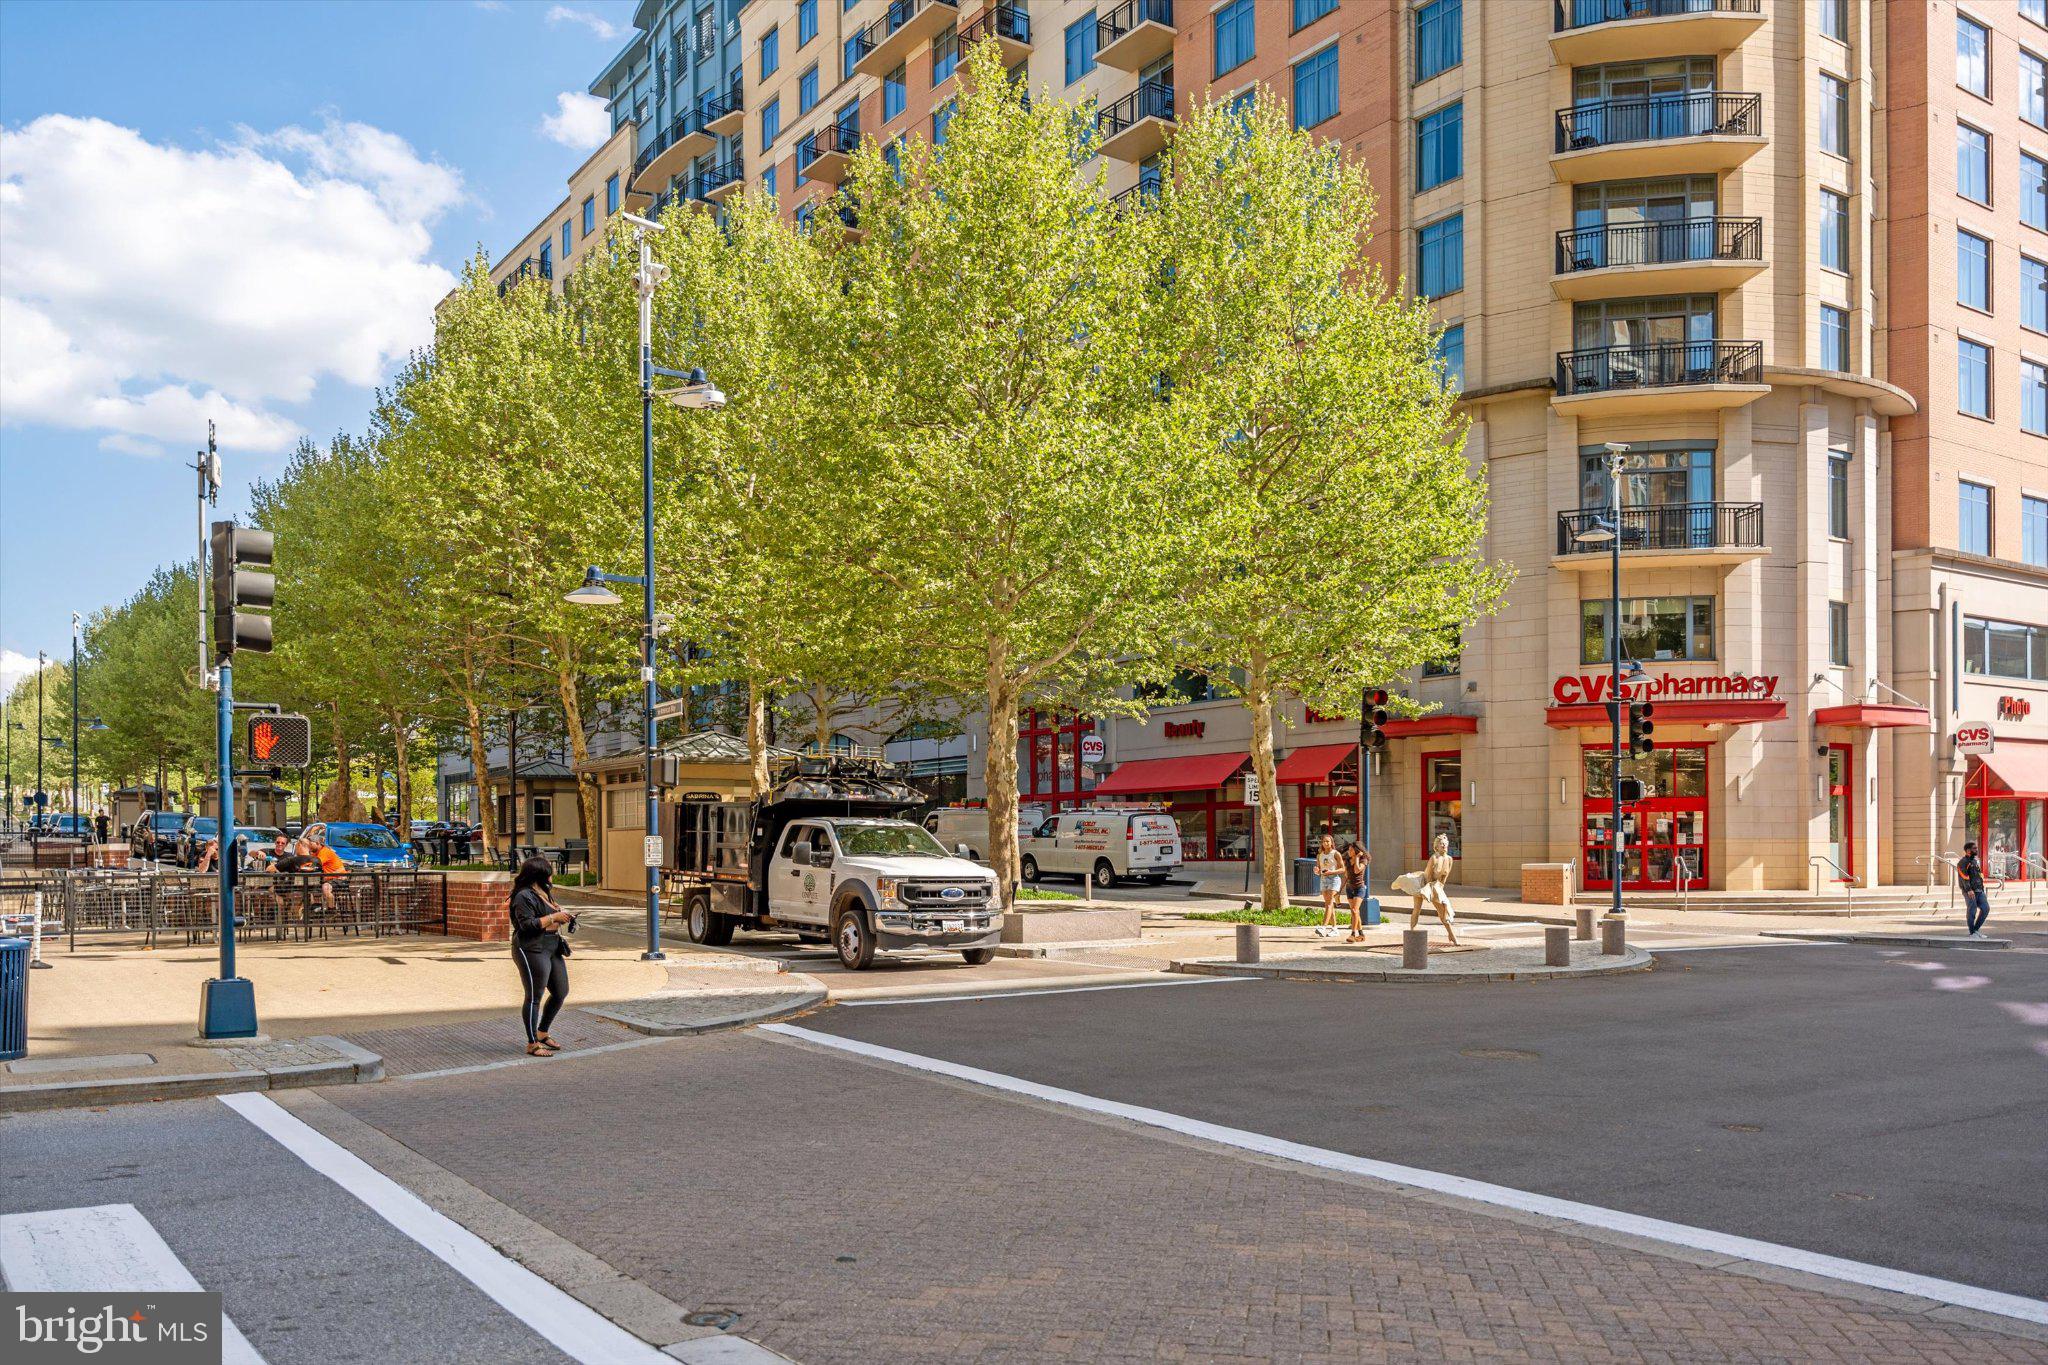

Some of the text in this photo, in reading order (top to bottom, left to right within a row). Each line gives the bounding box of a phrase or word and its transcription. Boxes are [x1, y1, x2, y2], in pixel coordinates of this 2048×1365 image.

[2004, 696, 2031, 715] Photo
[1164, 720, 1205, 738] Beauty
[1957, 727, 1990, 742] CVS
[1082, 741, 1103, 751] CVS
[1249, 790, 1260, 802] 15
